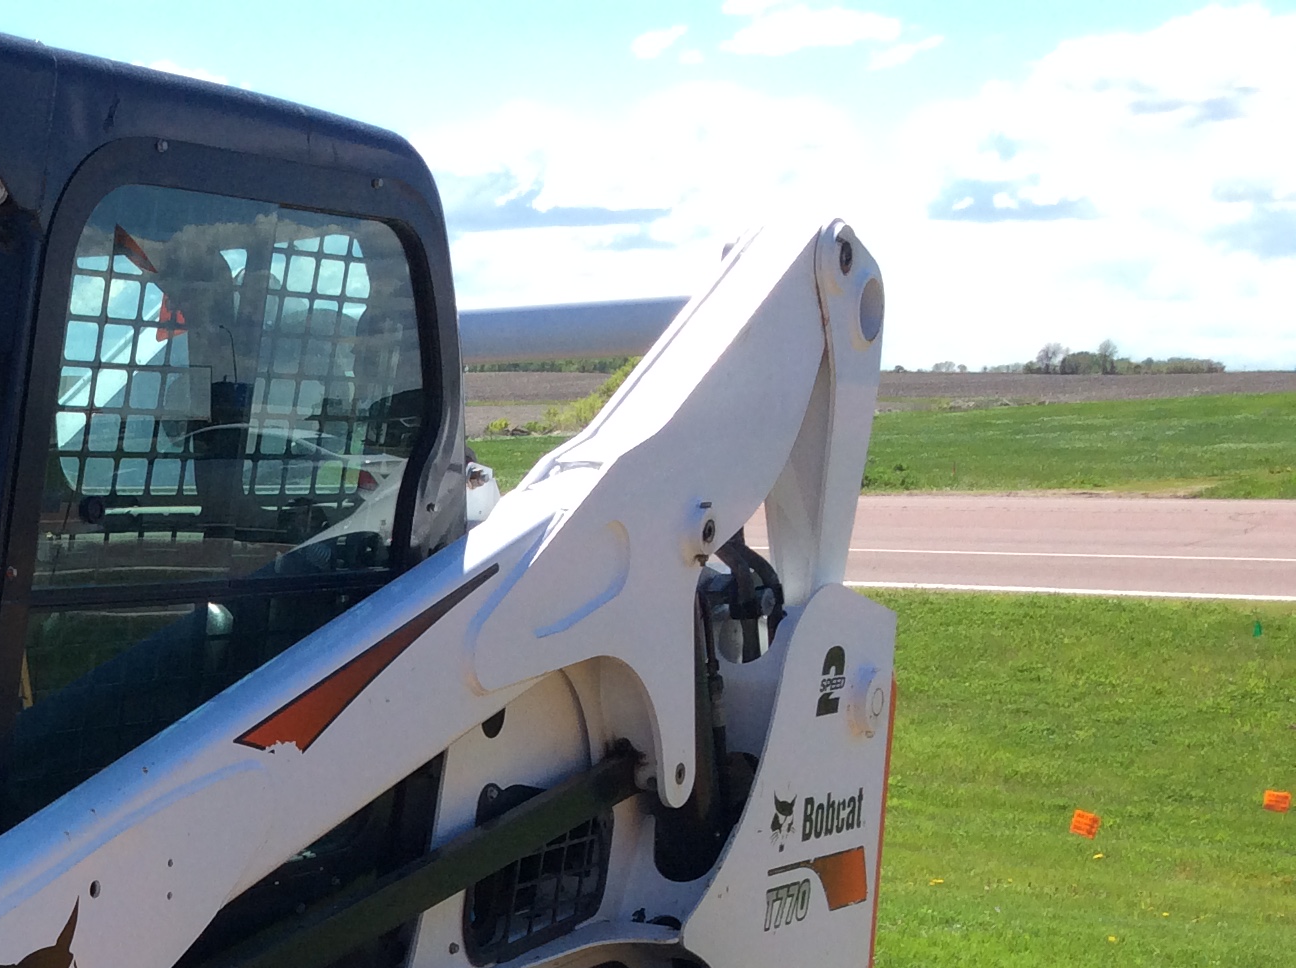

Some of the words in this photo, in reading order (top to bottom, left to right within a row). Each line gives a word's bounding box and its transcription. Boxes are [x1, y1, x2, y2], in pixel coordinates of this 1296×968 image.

[816, 645, 845, 716] 2
[820, 676, 846, 692] SPEED
[802, 788, 863, 841] Bobcat
[764, 878, 811, 931] T770
